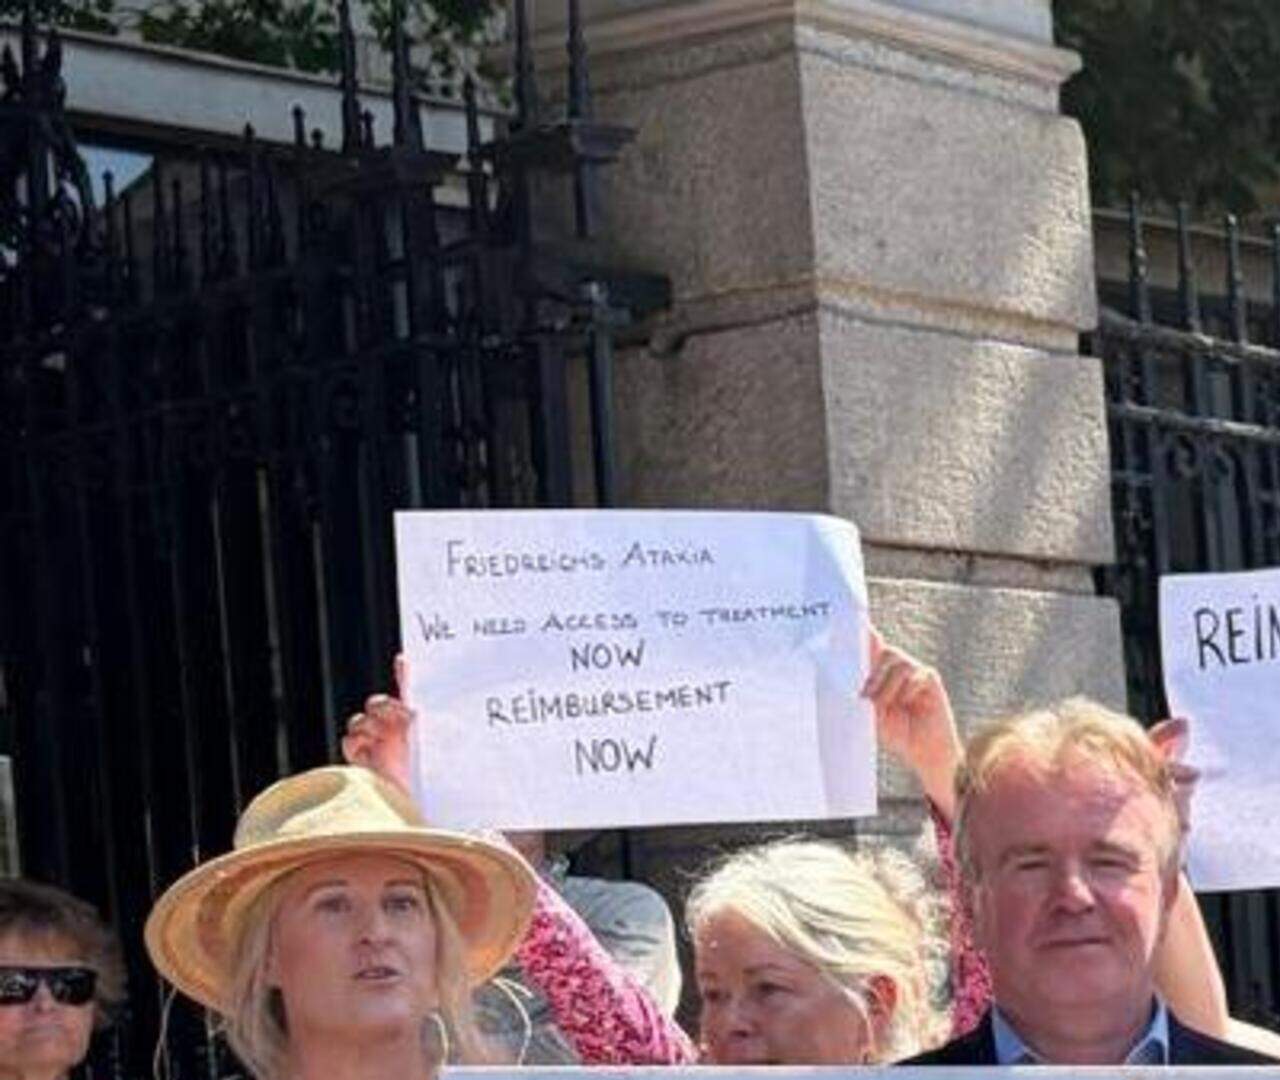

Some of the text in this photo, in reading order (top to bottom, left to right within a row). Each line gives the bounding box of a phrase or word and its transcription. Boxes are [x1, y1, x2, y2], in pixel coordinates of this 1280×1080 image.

[620, 541, 715, 568] ATAXIA
[473, 615, 526, 635] NEED
[541, 611, 638, 633] ACCESS
[656, 610, 688, 627] TO
[698, 602, 830, 627] TREATMENT
[571, 639, 646, 672] NOW
[485, 680, 733, 727] REIMBURSEMENT
[575, 735, 658, 776] NOW
